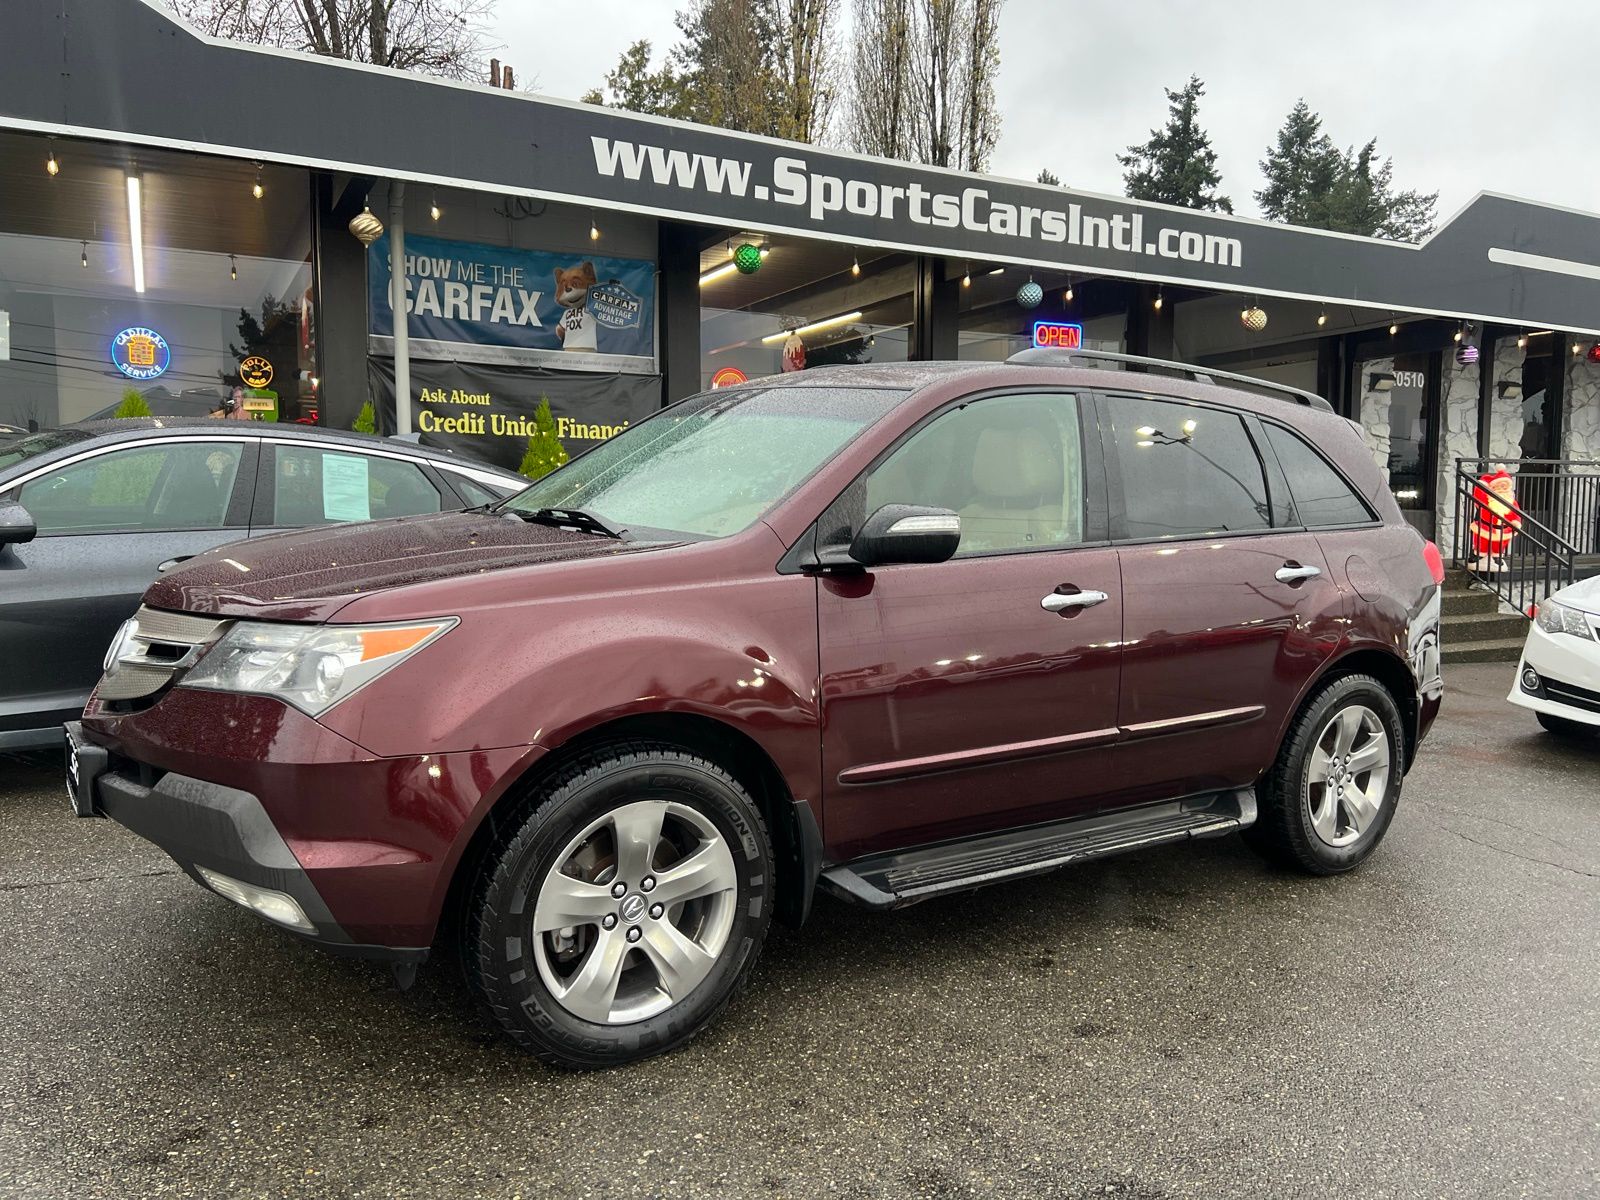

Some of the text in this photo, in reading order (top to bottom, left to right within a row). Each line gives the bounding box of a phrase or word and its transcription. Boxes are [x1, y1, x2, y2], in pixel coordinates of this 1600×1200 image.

[590, 136, 1242, 268] www.SportsCarsIntl.com
[457, 260, 485, 283] ME
[490, 265, 524, 288] THE
[592, 291, 638, 312] CARFAX
[593, 302, 632, 320] ADVANTAGE
[565, 307, 583, 320] CAR
[597, 313, 624, 326] DEALER
[565, 319, 582, 330] FOX
[116, 327, 165, 349] CADILLAC
[1036, 325, 1080, 347] OPEN
[120, 363, 163, 378] SERVICE
[420, 388, 491, 406] Ask About
[418, 410, 486, 435] Credit
[490, 414, 538, 437] Unio
